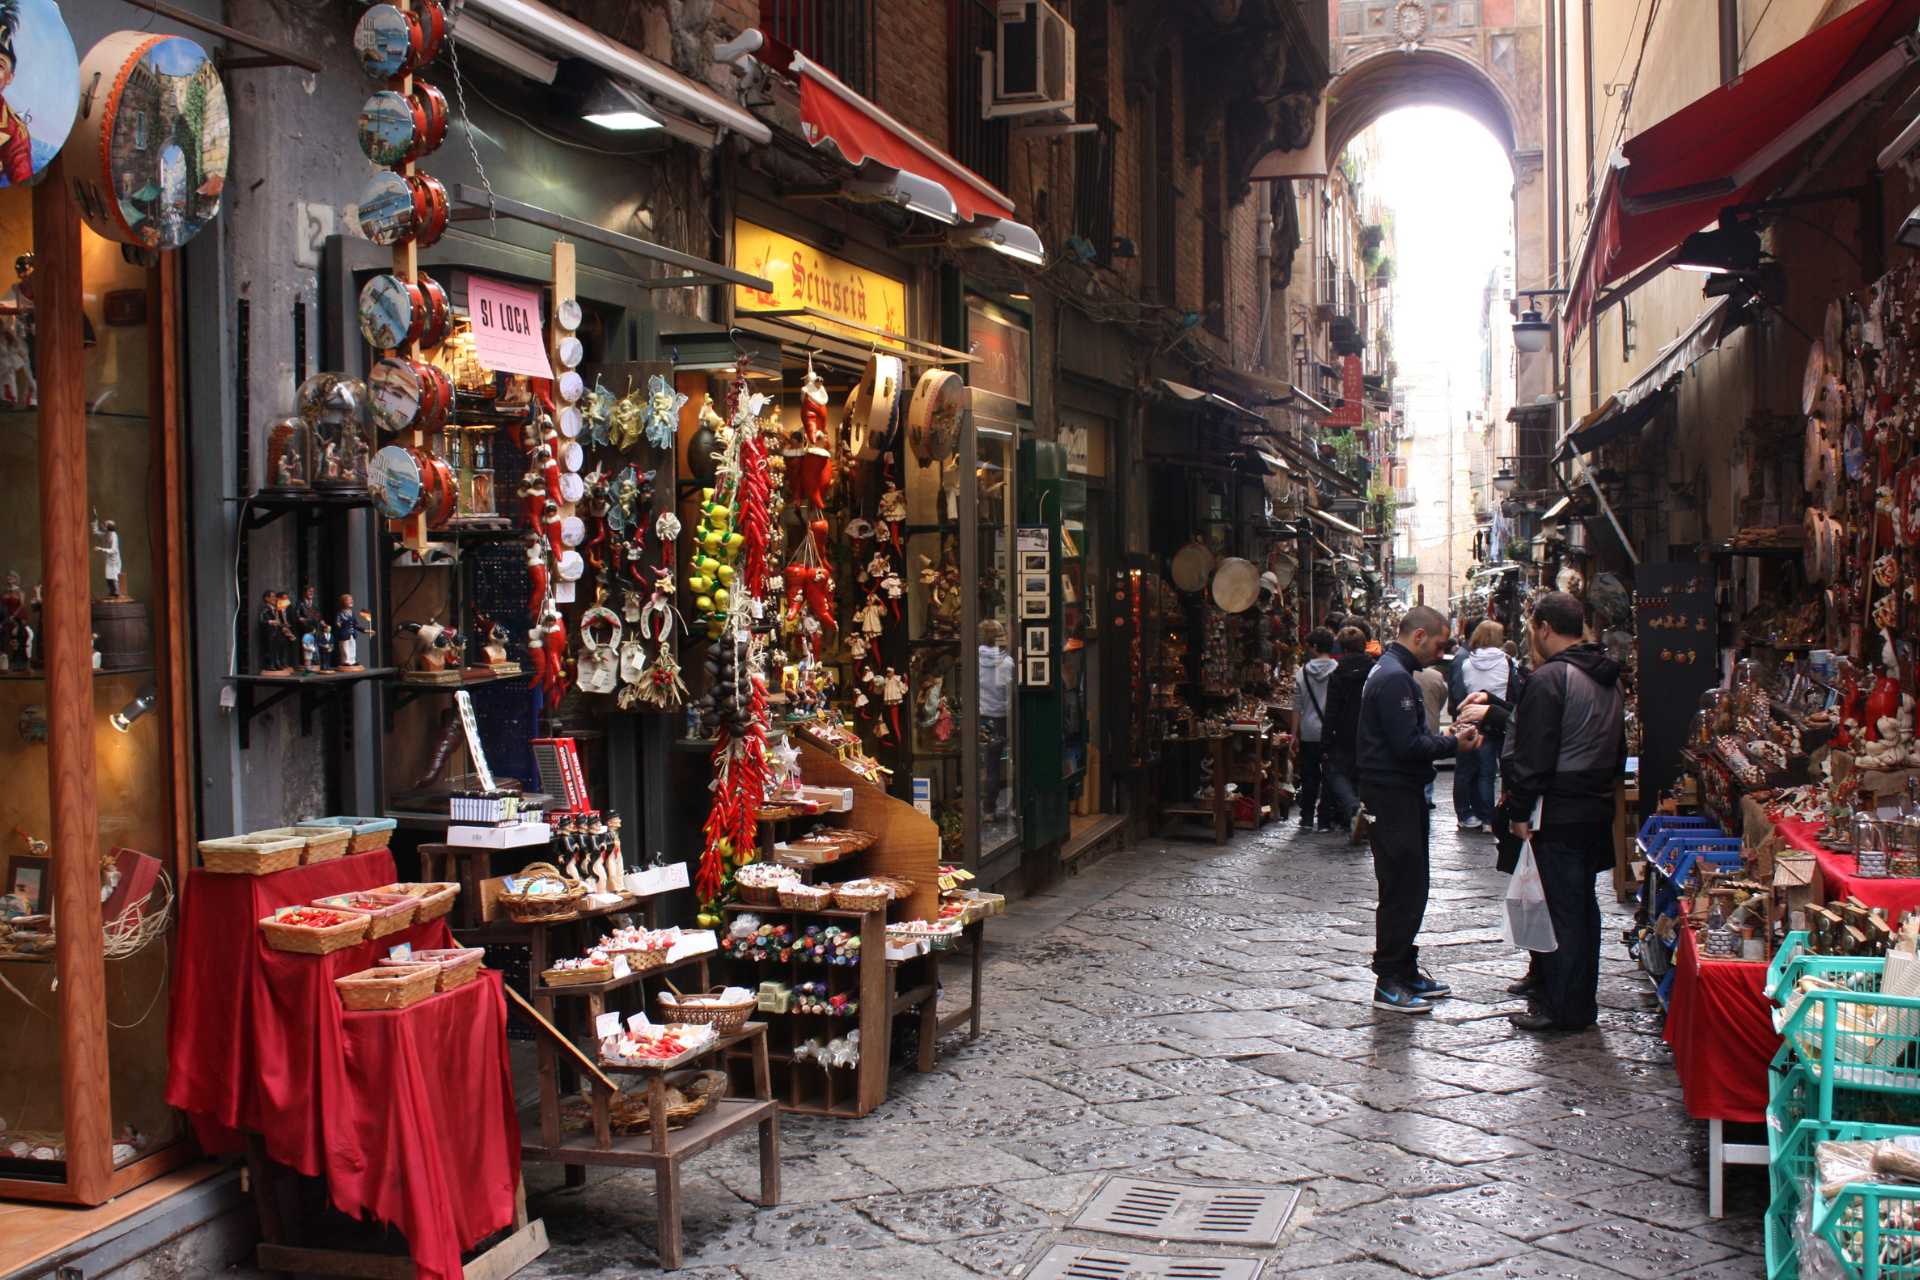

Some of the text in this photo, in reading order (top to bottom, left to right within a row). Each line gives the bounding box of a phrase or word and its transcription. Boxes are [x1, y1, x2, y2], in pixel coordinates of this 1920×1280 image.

[792, 251, 867, 320] Sciuscià
[480, 298, 531, 336] SI LOCA
[559, 746, 578, 805] CARTE DA GIOCO
[571, 751, 588, 799] NAPOLETANE
